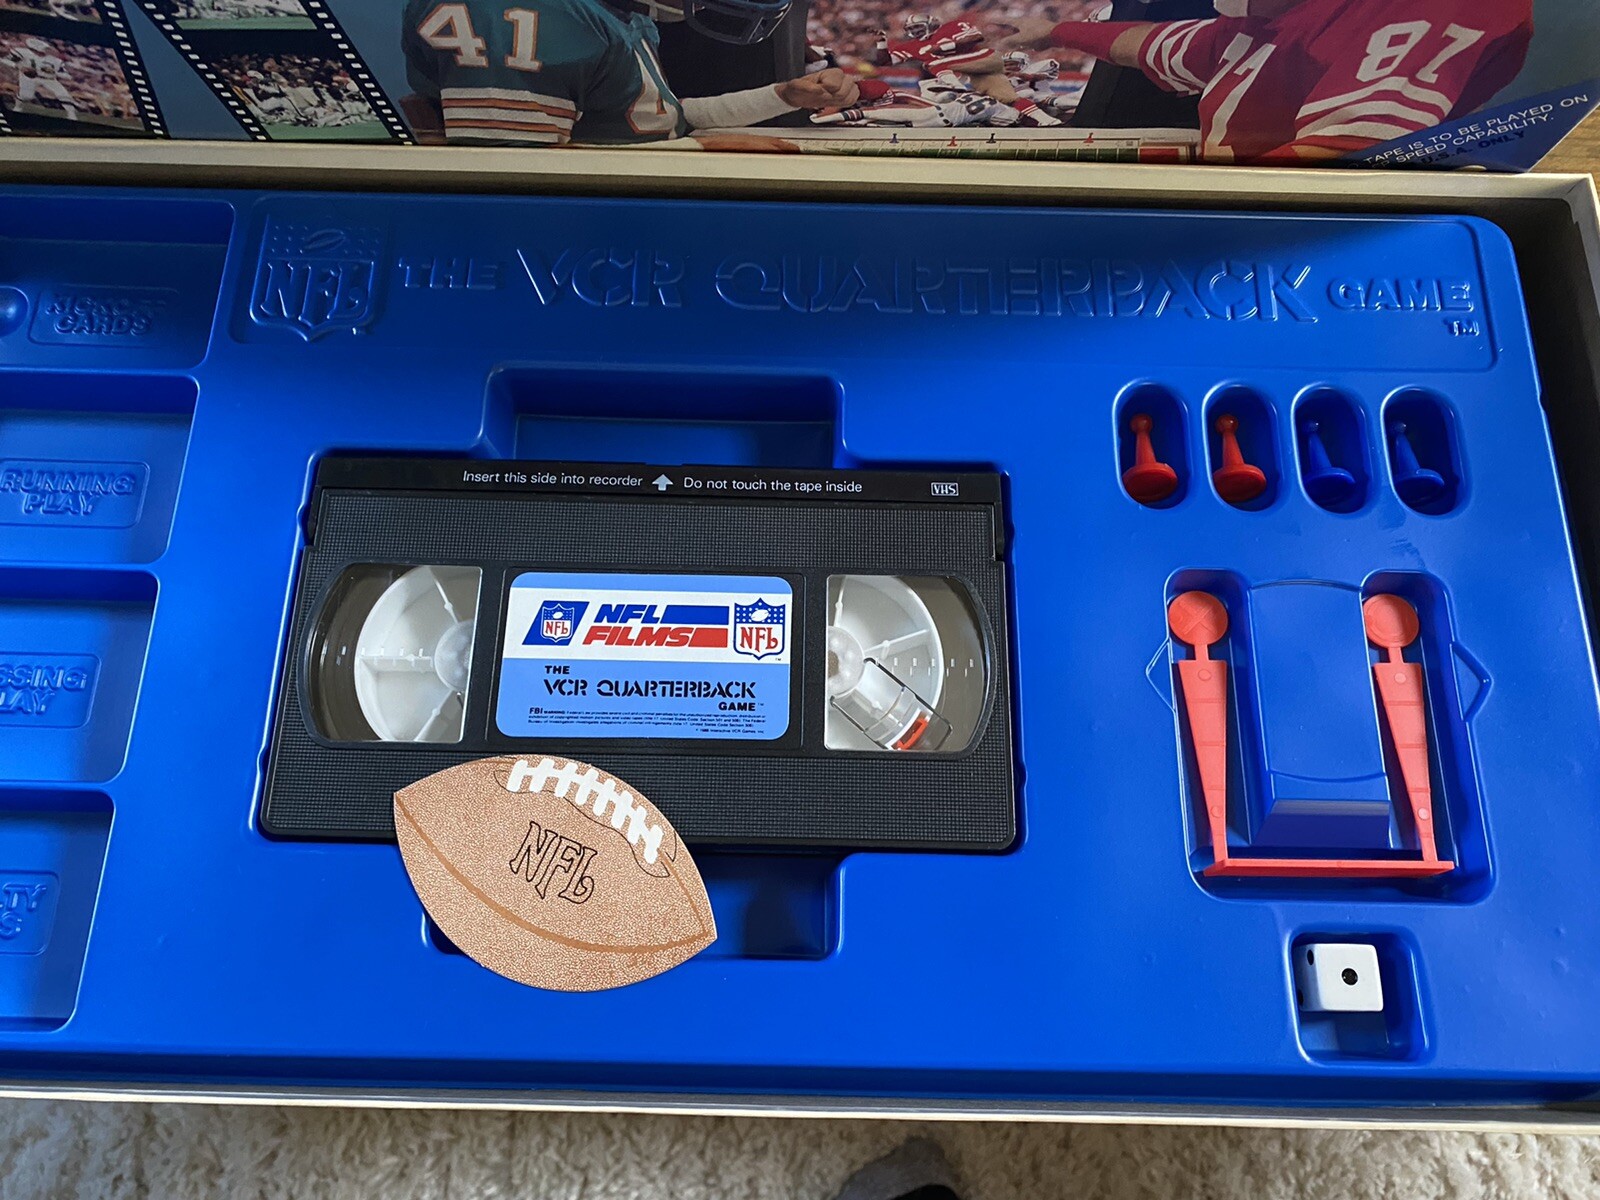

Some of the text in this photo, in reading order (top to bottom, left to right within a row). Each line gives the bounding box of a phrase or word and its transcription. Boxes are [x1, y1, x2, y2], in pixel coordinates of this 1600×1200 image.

[417, 3, 542, 73] 41
[1355, 20, 1485, 84] 87
[1364, 94, 1589, 164] TAPE IS TO BE PLAYED ON
[1395, 143, 1447, 162] SPEED
[1452, 115, 1554, 145] CAPABILITY.
[1421, 131, 1525, 164] U.S.A. ONLY
[260, 261, 367, 327] NFL
[398, 247, 1475, 324] THE VCR QUARTERBACK GAME
[45, 295, 167, 316] KICKO
[53, 312, 152, 337] CARDS
[0, 466, 136, 496] RUNNING
[462, 470, 643, 487] Insert this side into recorder
[683, 477, 862, 494] Do not touch the tape inside
[932, 483, 957, 495] VHS
[22, 491, 96, 516] PLAY
[593, 603, 660, 624] NFL
[545, 621, 568, 636] NFL
[582, 625, 695, 648] FILMS
[740, 627, 779, 652] NFL
[0, 663, 87, 692] SSING
[545, 665, 570, 675] THE
[543, 679, 757, 699] VCR QUARTERBACK
[0, 690, 56, 716] LAY
[718, 702, 756, 712] GAME
[509, 820, 598, 904] NFL
